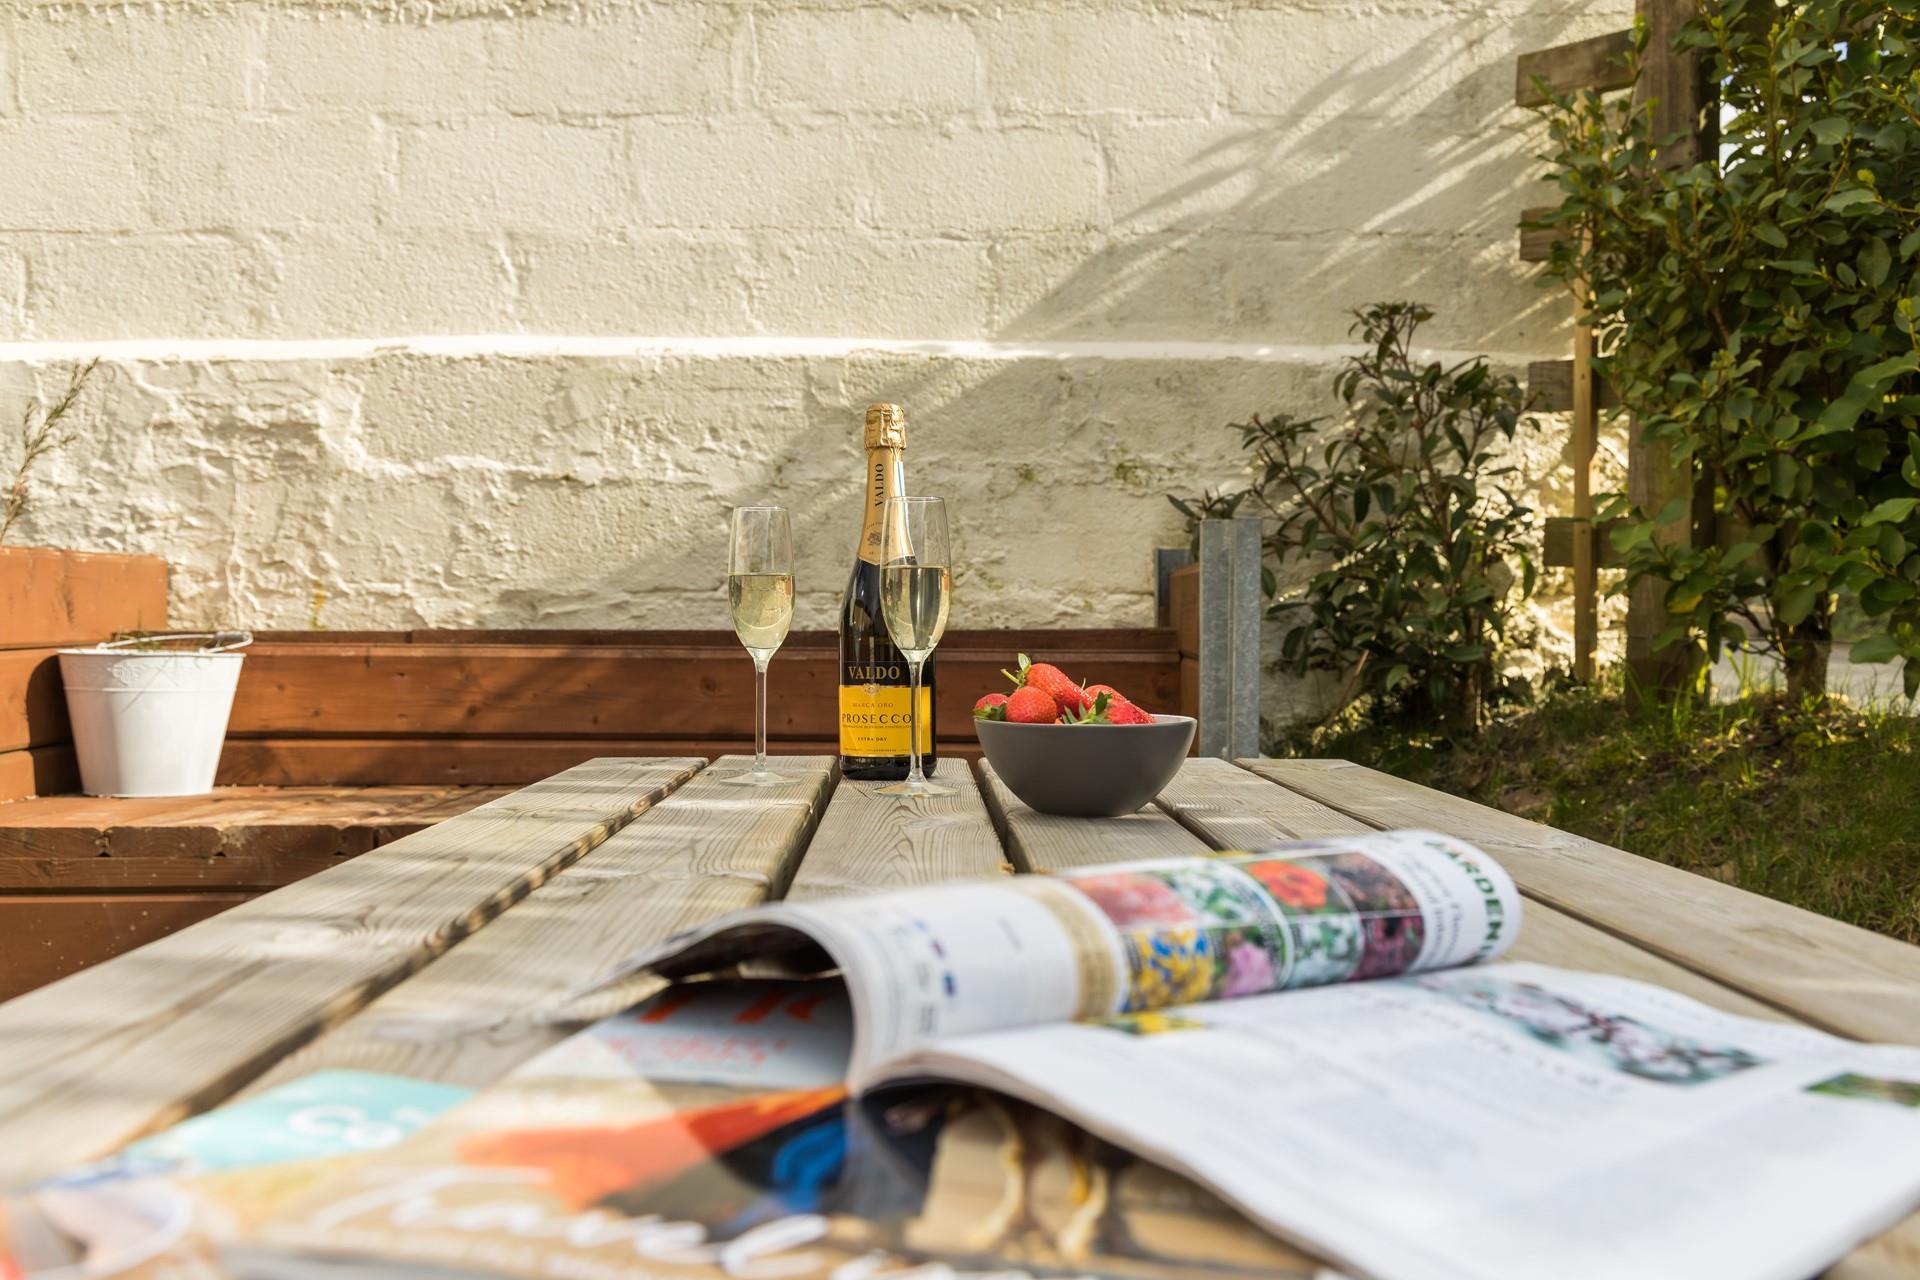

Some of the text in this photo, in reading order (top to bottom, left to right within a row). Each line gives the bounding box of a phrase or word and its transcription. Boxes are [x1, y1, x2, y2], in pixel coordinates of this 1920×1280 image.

[875, 463, 884, 507] VALDO
[848, 666, 900, 679] VALDO
[842, 714, 912, 724] PROSECCO
